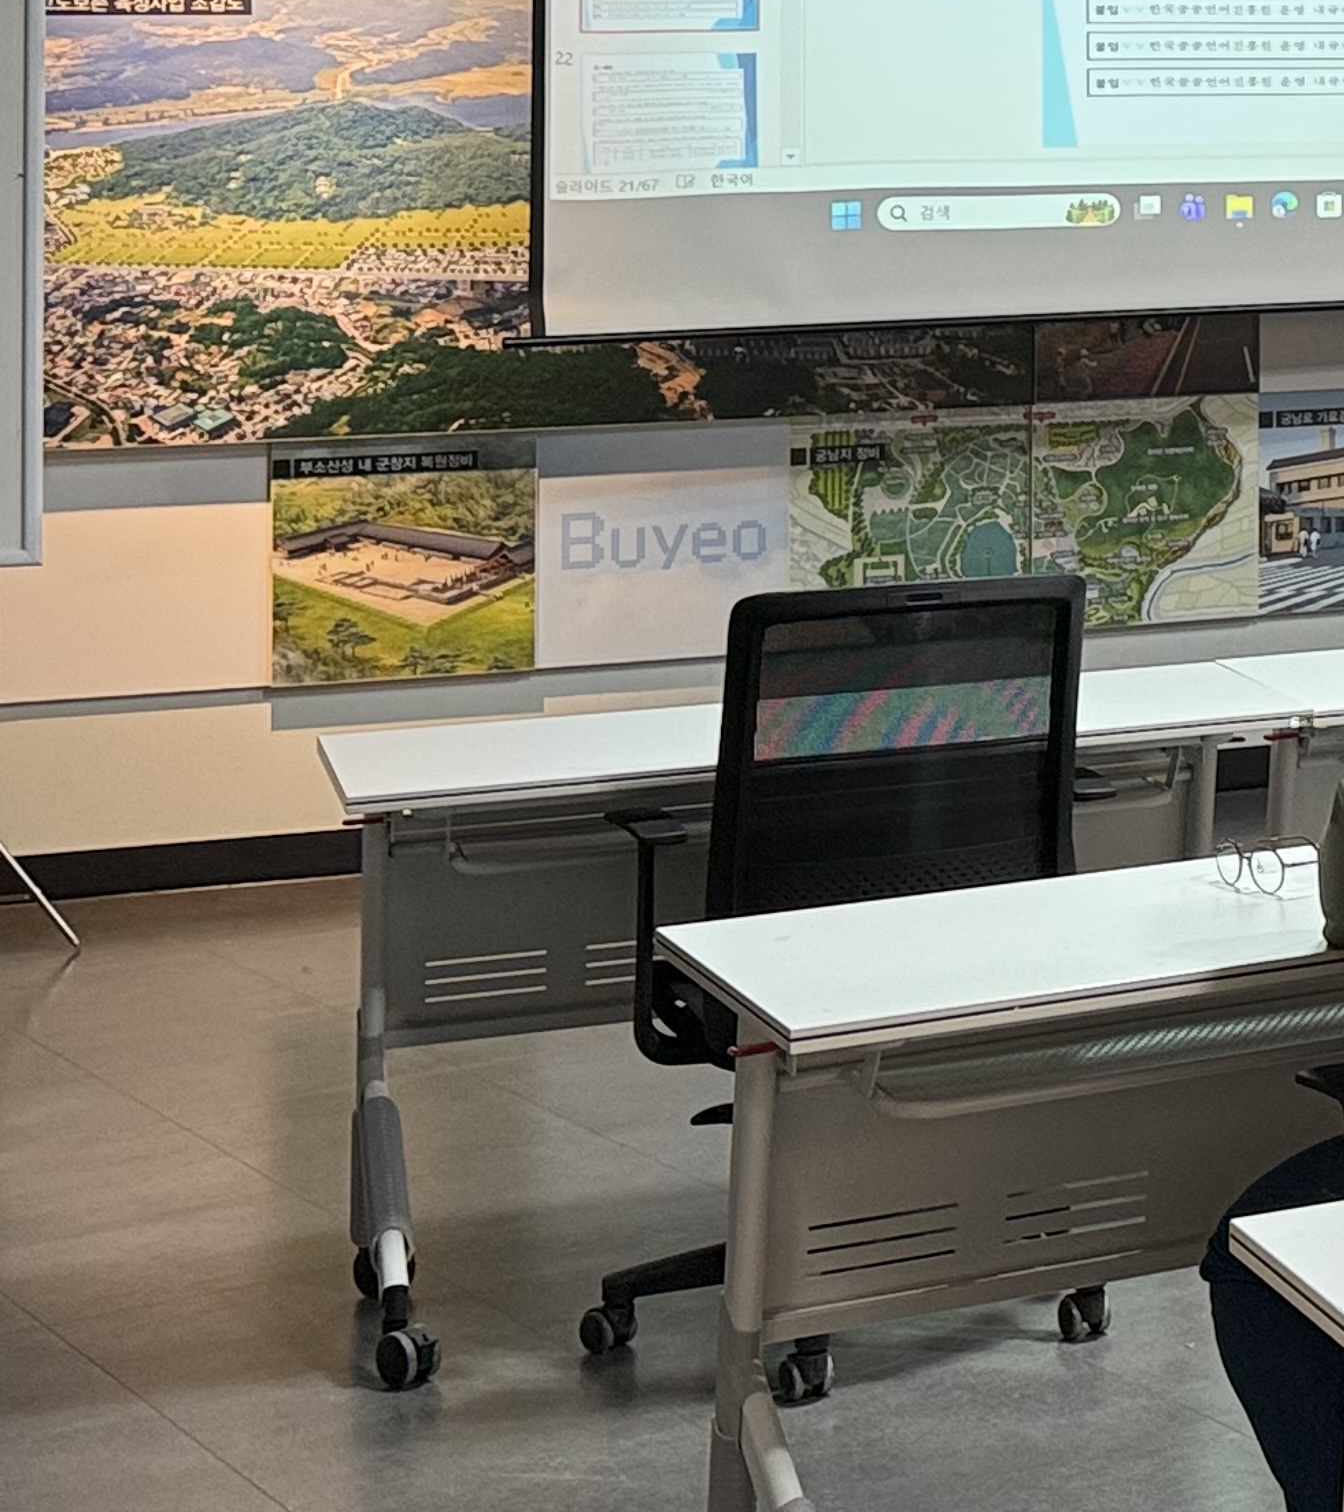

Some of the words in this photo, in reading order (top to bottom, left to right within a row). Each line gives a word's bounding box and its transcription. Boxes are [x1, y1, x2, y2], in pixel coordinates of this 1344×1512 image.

[555, 51, 573, 67] 22
[556, 179, 613, 194] 슬라이드
[619, 177, 659, 192] 21/67
[711, 173, 753, 188] 한국어
[920, 204, 951, 222] 검색
[815, 448, 852, 464] 궁남지
[856, 445, 880, 461] 정비
[300, 458, 354, 476] 부소산성
[358, 457, 372, 473] 내
[561, 511, 767, 571] Buyeo
